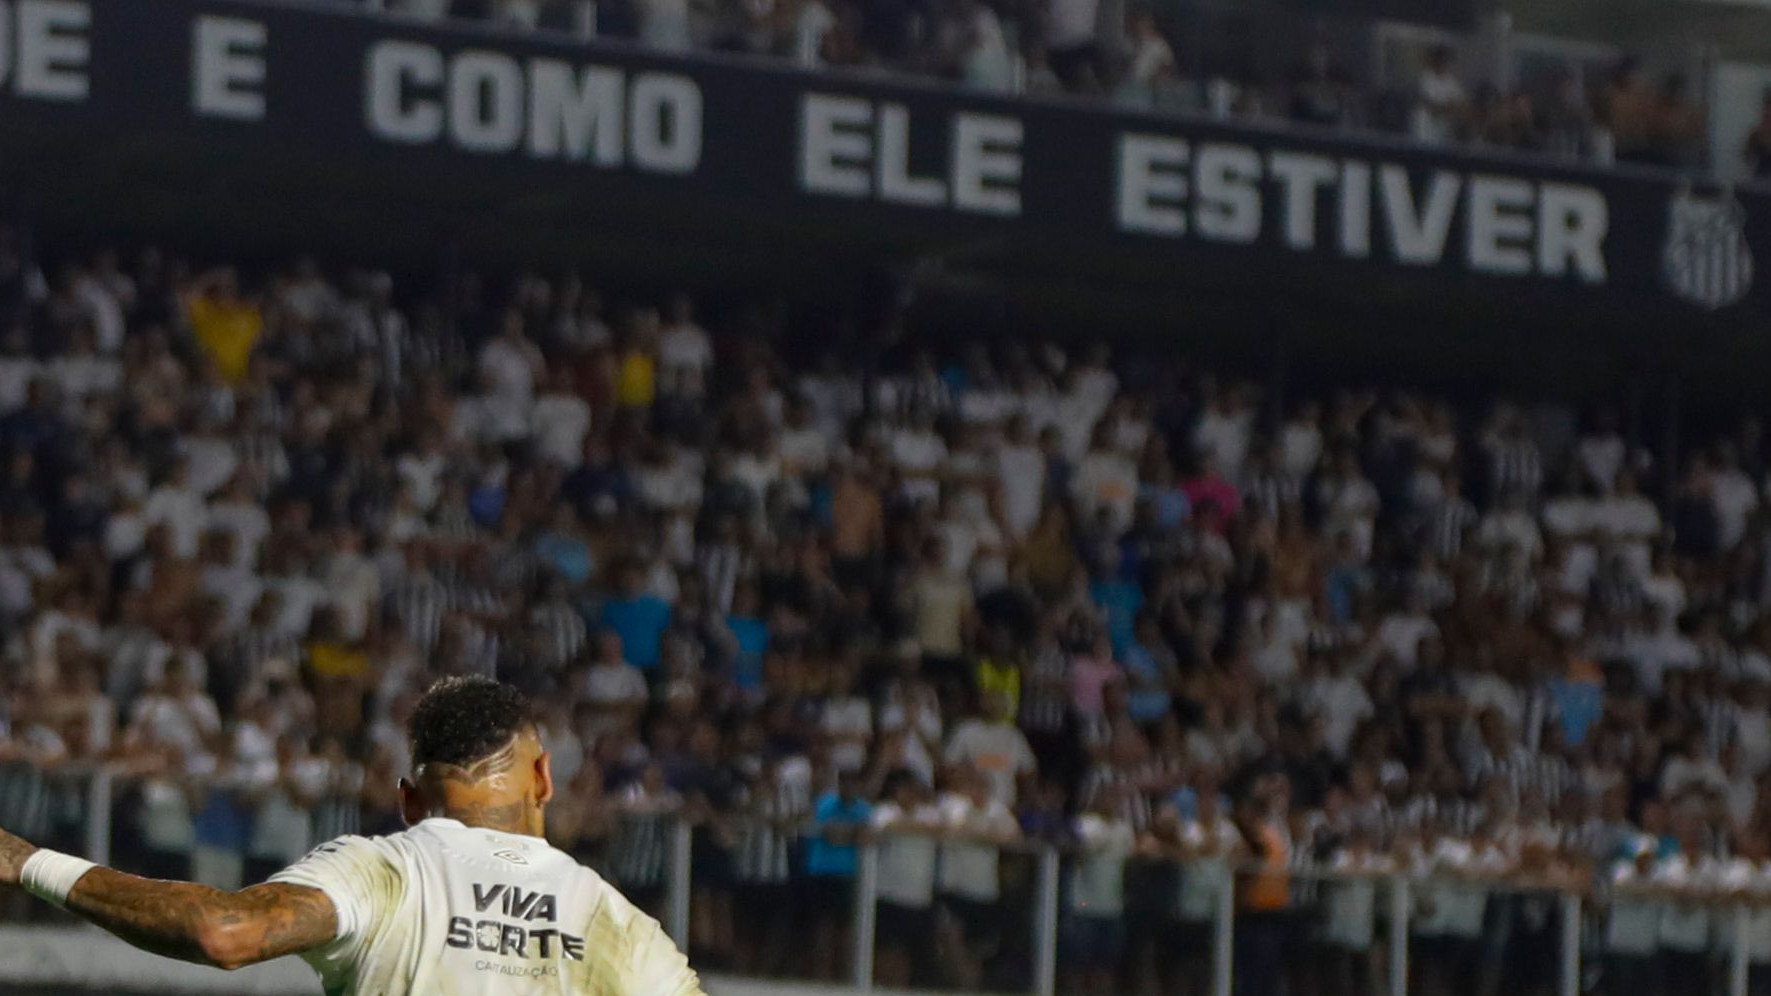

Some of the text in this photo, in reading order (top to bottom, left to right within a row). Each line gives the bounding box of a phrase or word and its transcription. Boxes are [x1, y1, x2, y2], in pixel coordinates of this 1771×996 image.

[191, 15, 268, 118] E
[365, 40, 702, 173] COMO
[799, 94, 1022, 212] ELE
[1114, 132, 1609, 282] ESTIVER
[473, 883, 557, 922] VIVA
[447, 916, 585, 961] SORTE
